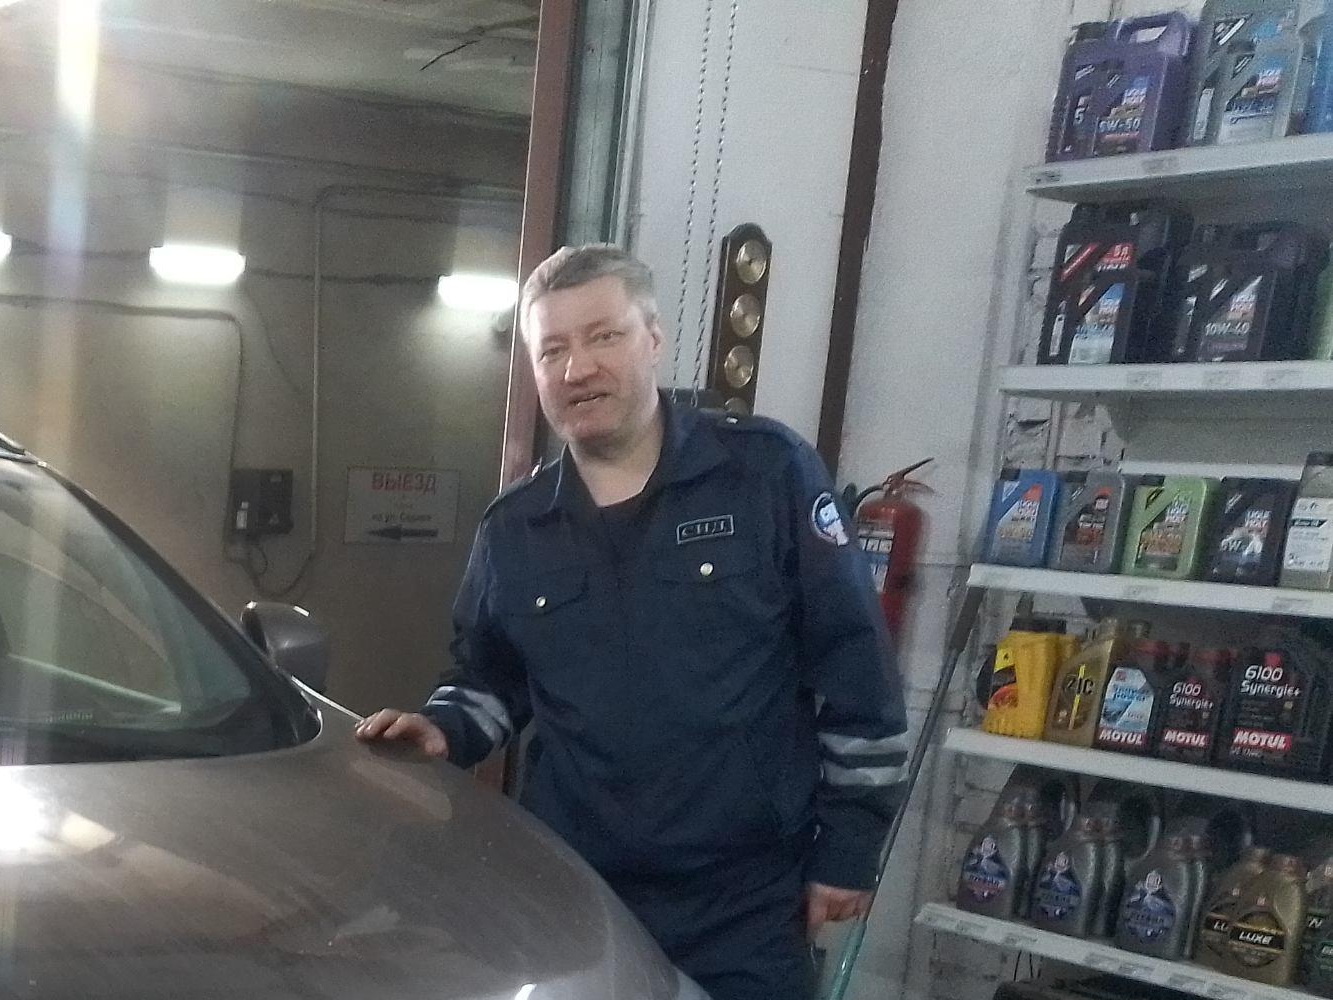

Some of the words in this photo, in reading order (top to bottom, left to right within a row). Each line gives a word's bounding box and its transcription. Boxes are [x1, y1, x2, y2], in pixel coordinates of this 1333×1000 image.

[371, 472, 437, 495] ВЫЕЗД
[1245, 665, 1284, 682] 6100
[1067, 674, 1094, 695] ZIC
[1173, 682, 1202, 696] 6100
[1240, 680, 1302, 699] Synergie+
[1099, 729, 1143, 746] MOTUL
[1164, 730, 1207, 747] MOTUL
[1234, 731, 1287, 749] MOTUL
